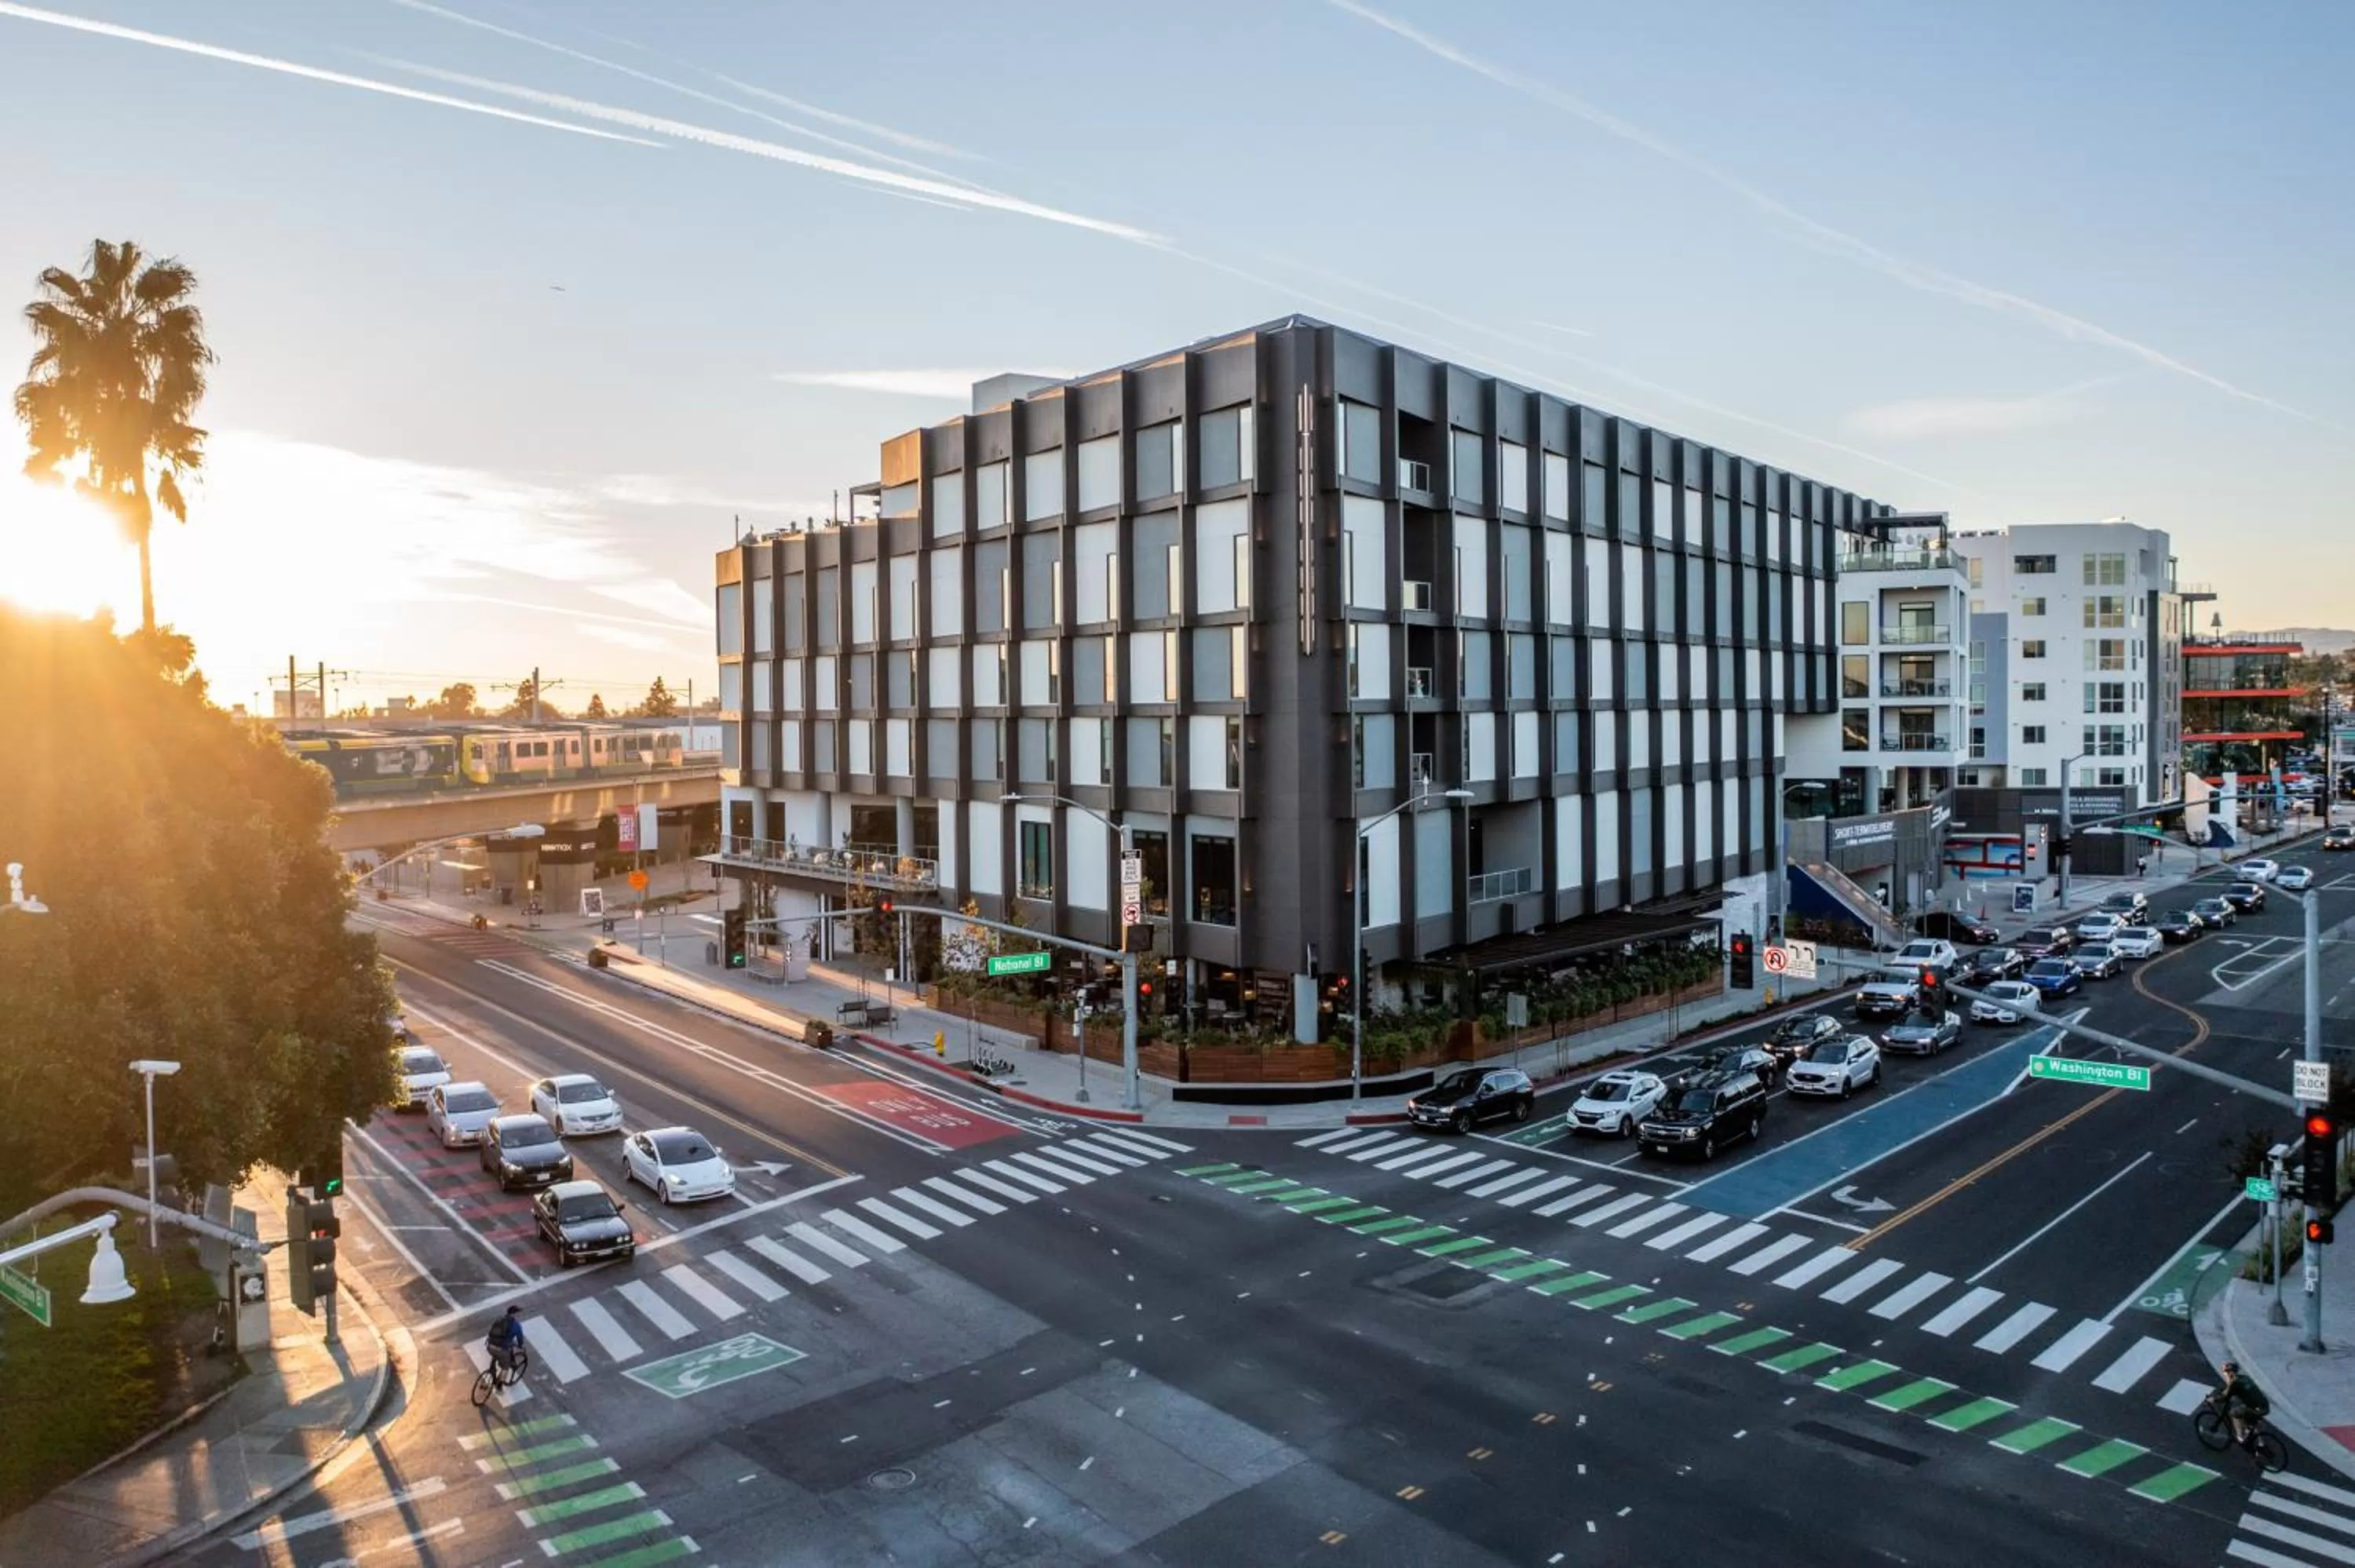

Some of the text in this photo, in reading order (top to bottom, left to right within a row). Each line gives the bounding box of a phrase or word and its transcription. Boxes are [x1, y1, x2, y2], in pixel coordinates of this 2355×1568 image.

[995, 957, 1032, 972] National
[2050, 1059, 2123, 1079] Washington
[2127, 1067, 2141, 1081] Bl
[2296, 1065, 2327, 1078] DO NOT
[2296, 1078, 2327, 1089] BLOCK
[909, 1113, 973, 1129] BUS
